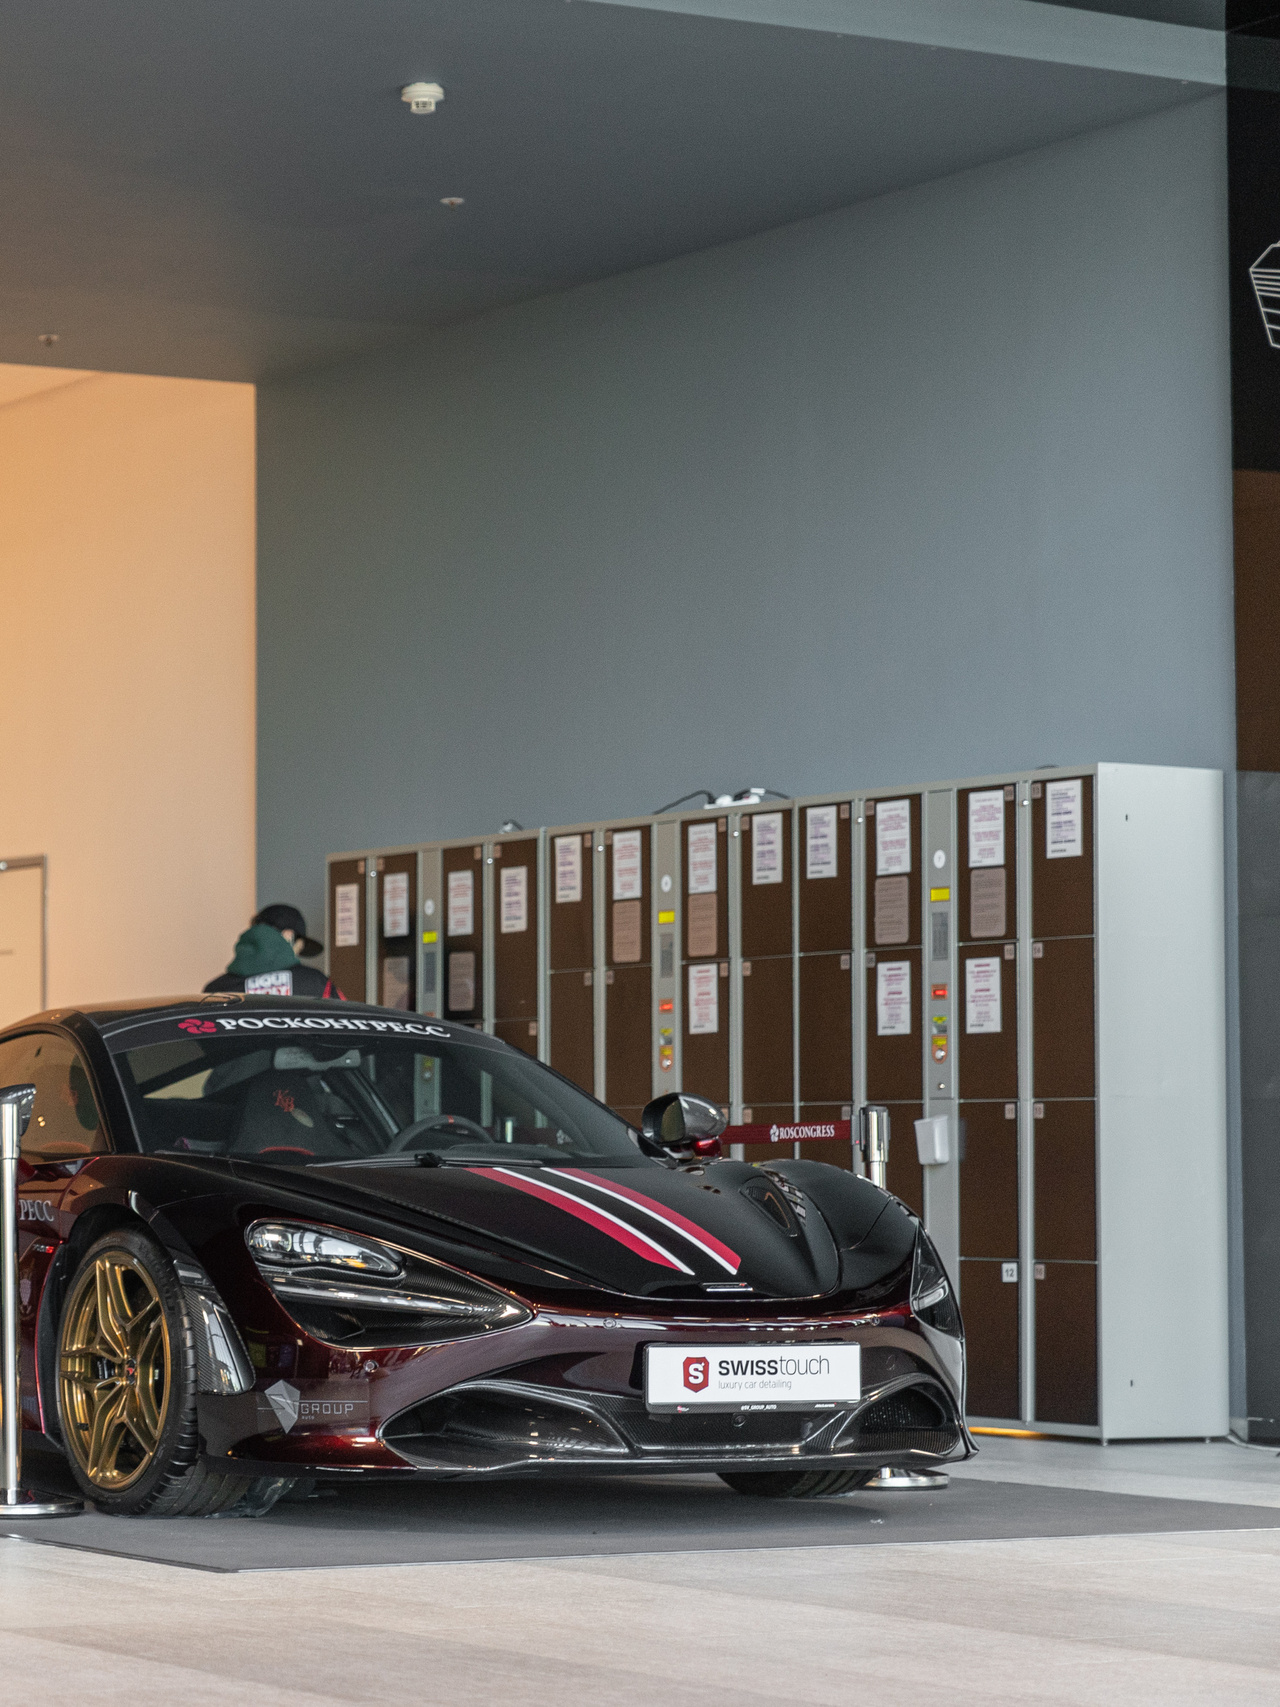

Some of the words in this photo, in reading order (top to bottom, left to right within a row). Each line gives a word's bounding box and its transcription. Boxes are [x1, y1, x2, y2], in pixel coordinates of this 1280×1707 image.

[215, 1017, 451, 1037] РОСКОНГРЕСС
[779, 1124, 835, 1140] ROSCONGRESS
[1005, 1267, 1014, 1278] 12
[718, 1355, 830, 1376] SWISStouch
[718, 1380, 742, 1390] luxury
[744, 1381, 758, 1389] car
[760, 1379, 792, 1390] detailing
[300, 1403, 354, 1415] GROUP
